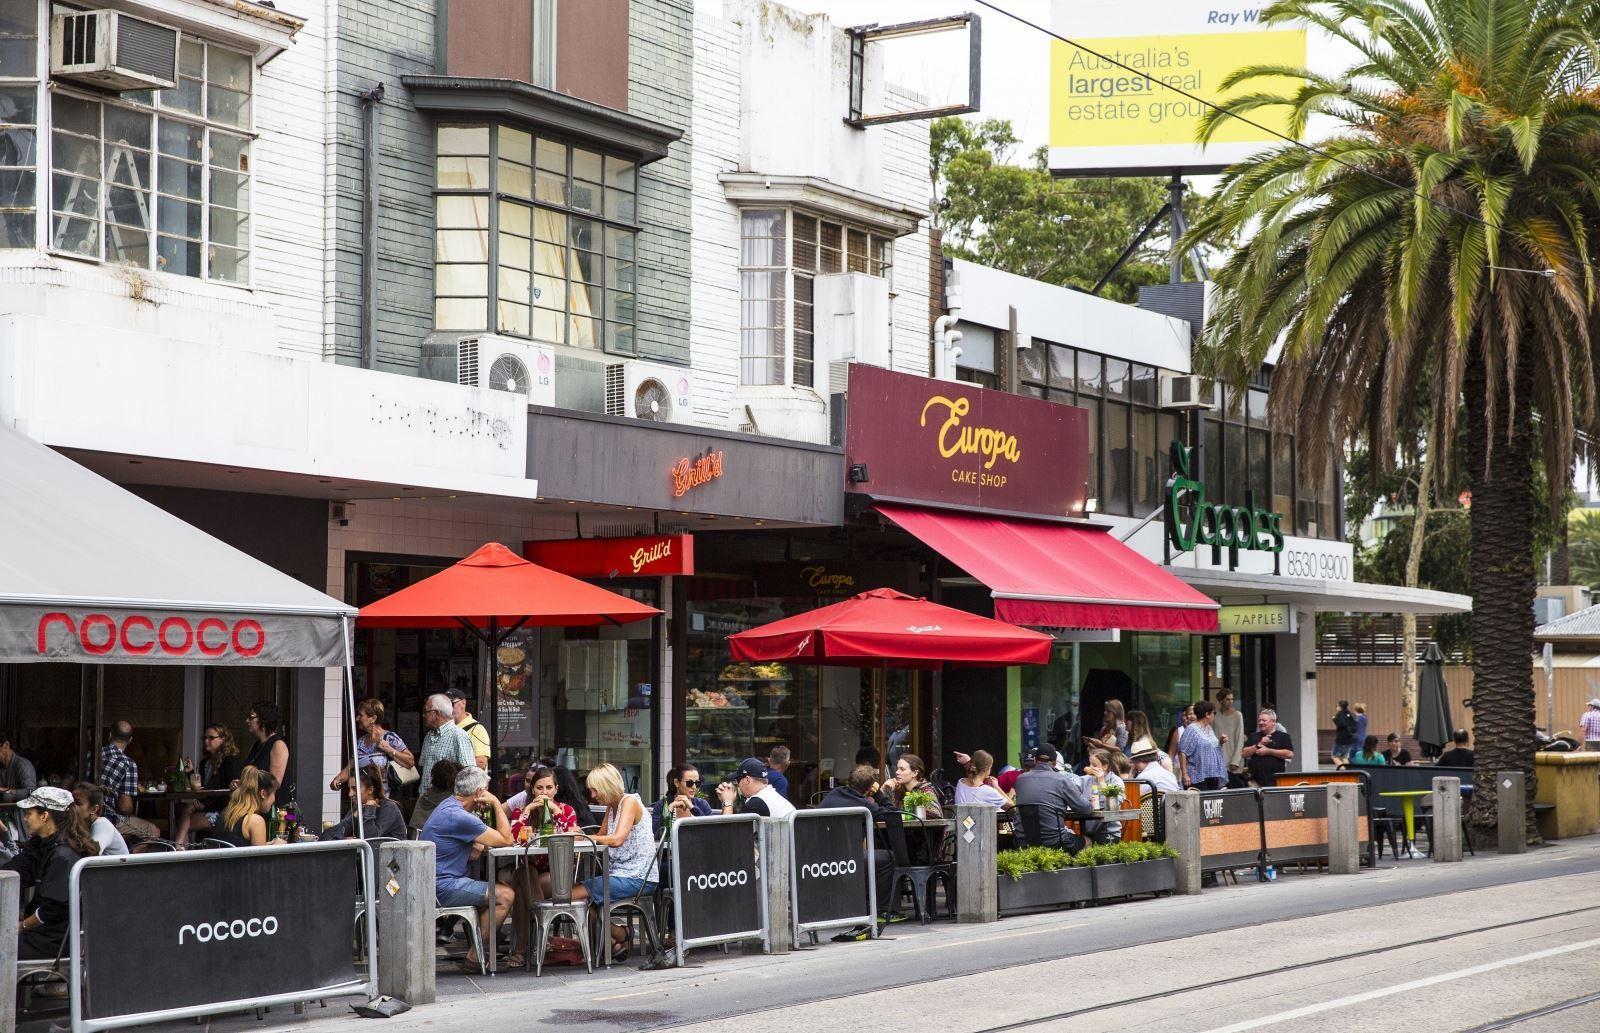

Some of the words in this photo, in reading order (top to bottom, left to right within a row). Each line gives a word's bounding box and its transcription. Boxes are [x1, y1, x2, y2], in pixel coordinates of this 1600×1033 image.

[1207, 10, 1240, 26] Ray
[1068, 46, 1190, 71] Australia's
[1068, 73, 1152, 98] largest
[1160, 70, 1202, 91] real
[1068, 100, 1140, 121] estate
[538, 375, 549, 386] LG
[678, 397, 689, 407] LG
[920, 395, 1021, 470] Europa
[671, 450, 723, 497] Grill'd
[951, 469, 977, 485] CAKE
[980, 473, 1007, 488] SHOP
[630, 539, 672, 574] Grill'd
[1287, 550, 1318, 578] 8530
[1319, 553, 1349, 581] 9900
[799, 566, 855, 589] Europa
[37, 612, 266, 657] rococo
[687, 869, 748, 892] rococo
[801, 859, 857, 880] rococo
[178, 915, 279, 945] rococo
